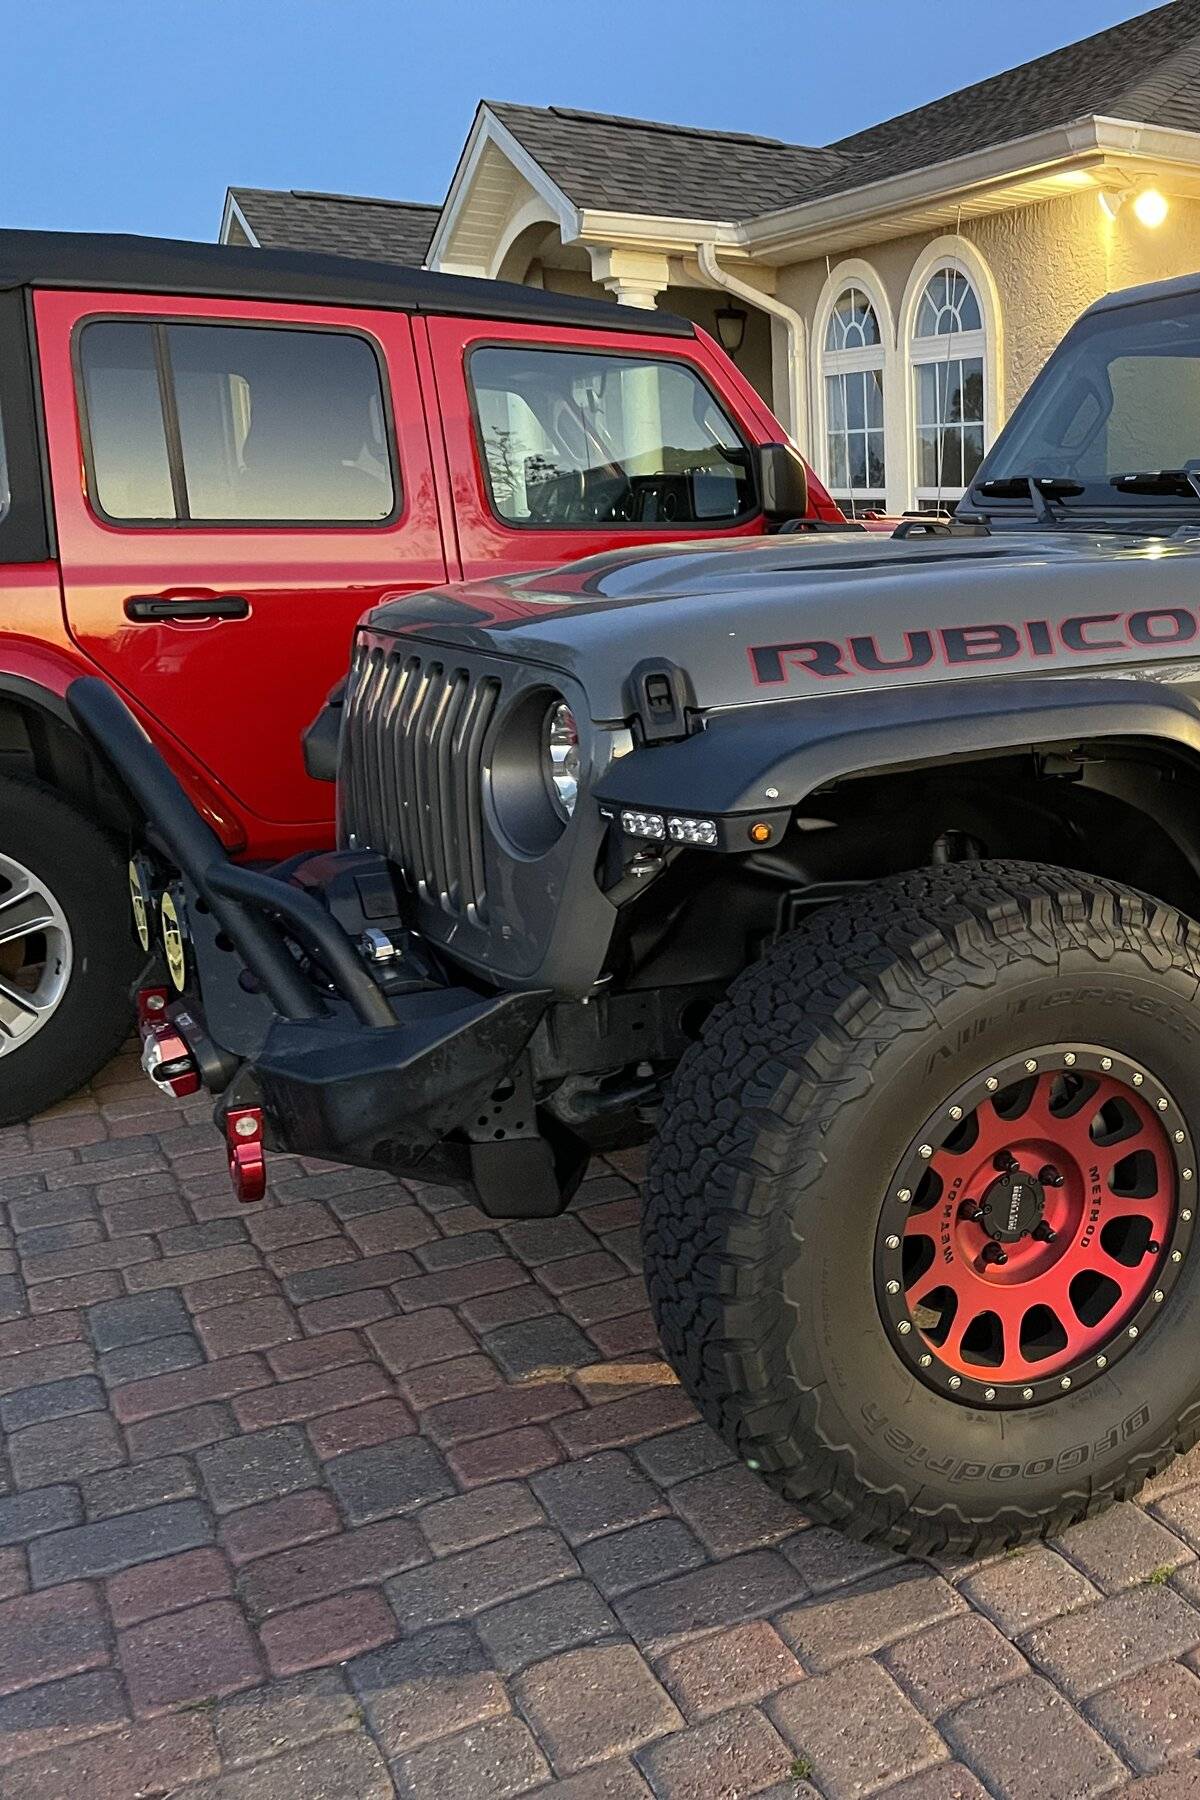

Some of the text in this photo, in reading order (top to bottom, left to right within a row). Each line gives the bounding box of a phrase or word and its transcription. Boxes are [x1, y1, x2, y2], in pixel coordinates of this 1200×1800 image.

[940, 1176, 963, 1265] METHOD
[1080, 1165, 1102, 1248] METHOD
[861, 1401, 1151, 1483] BFGoodrich
